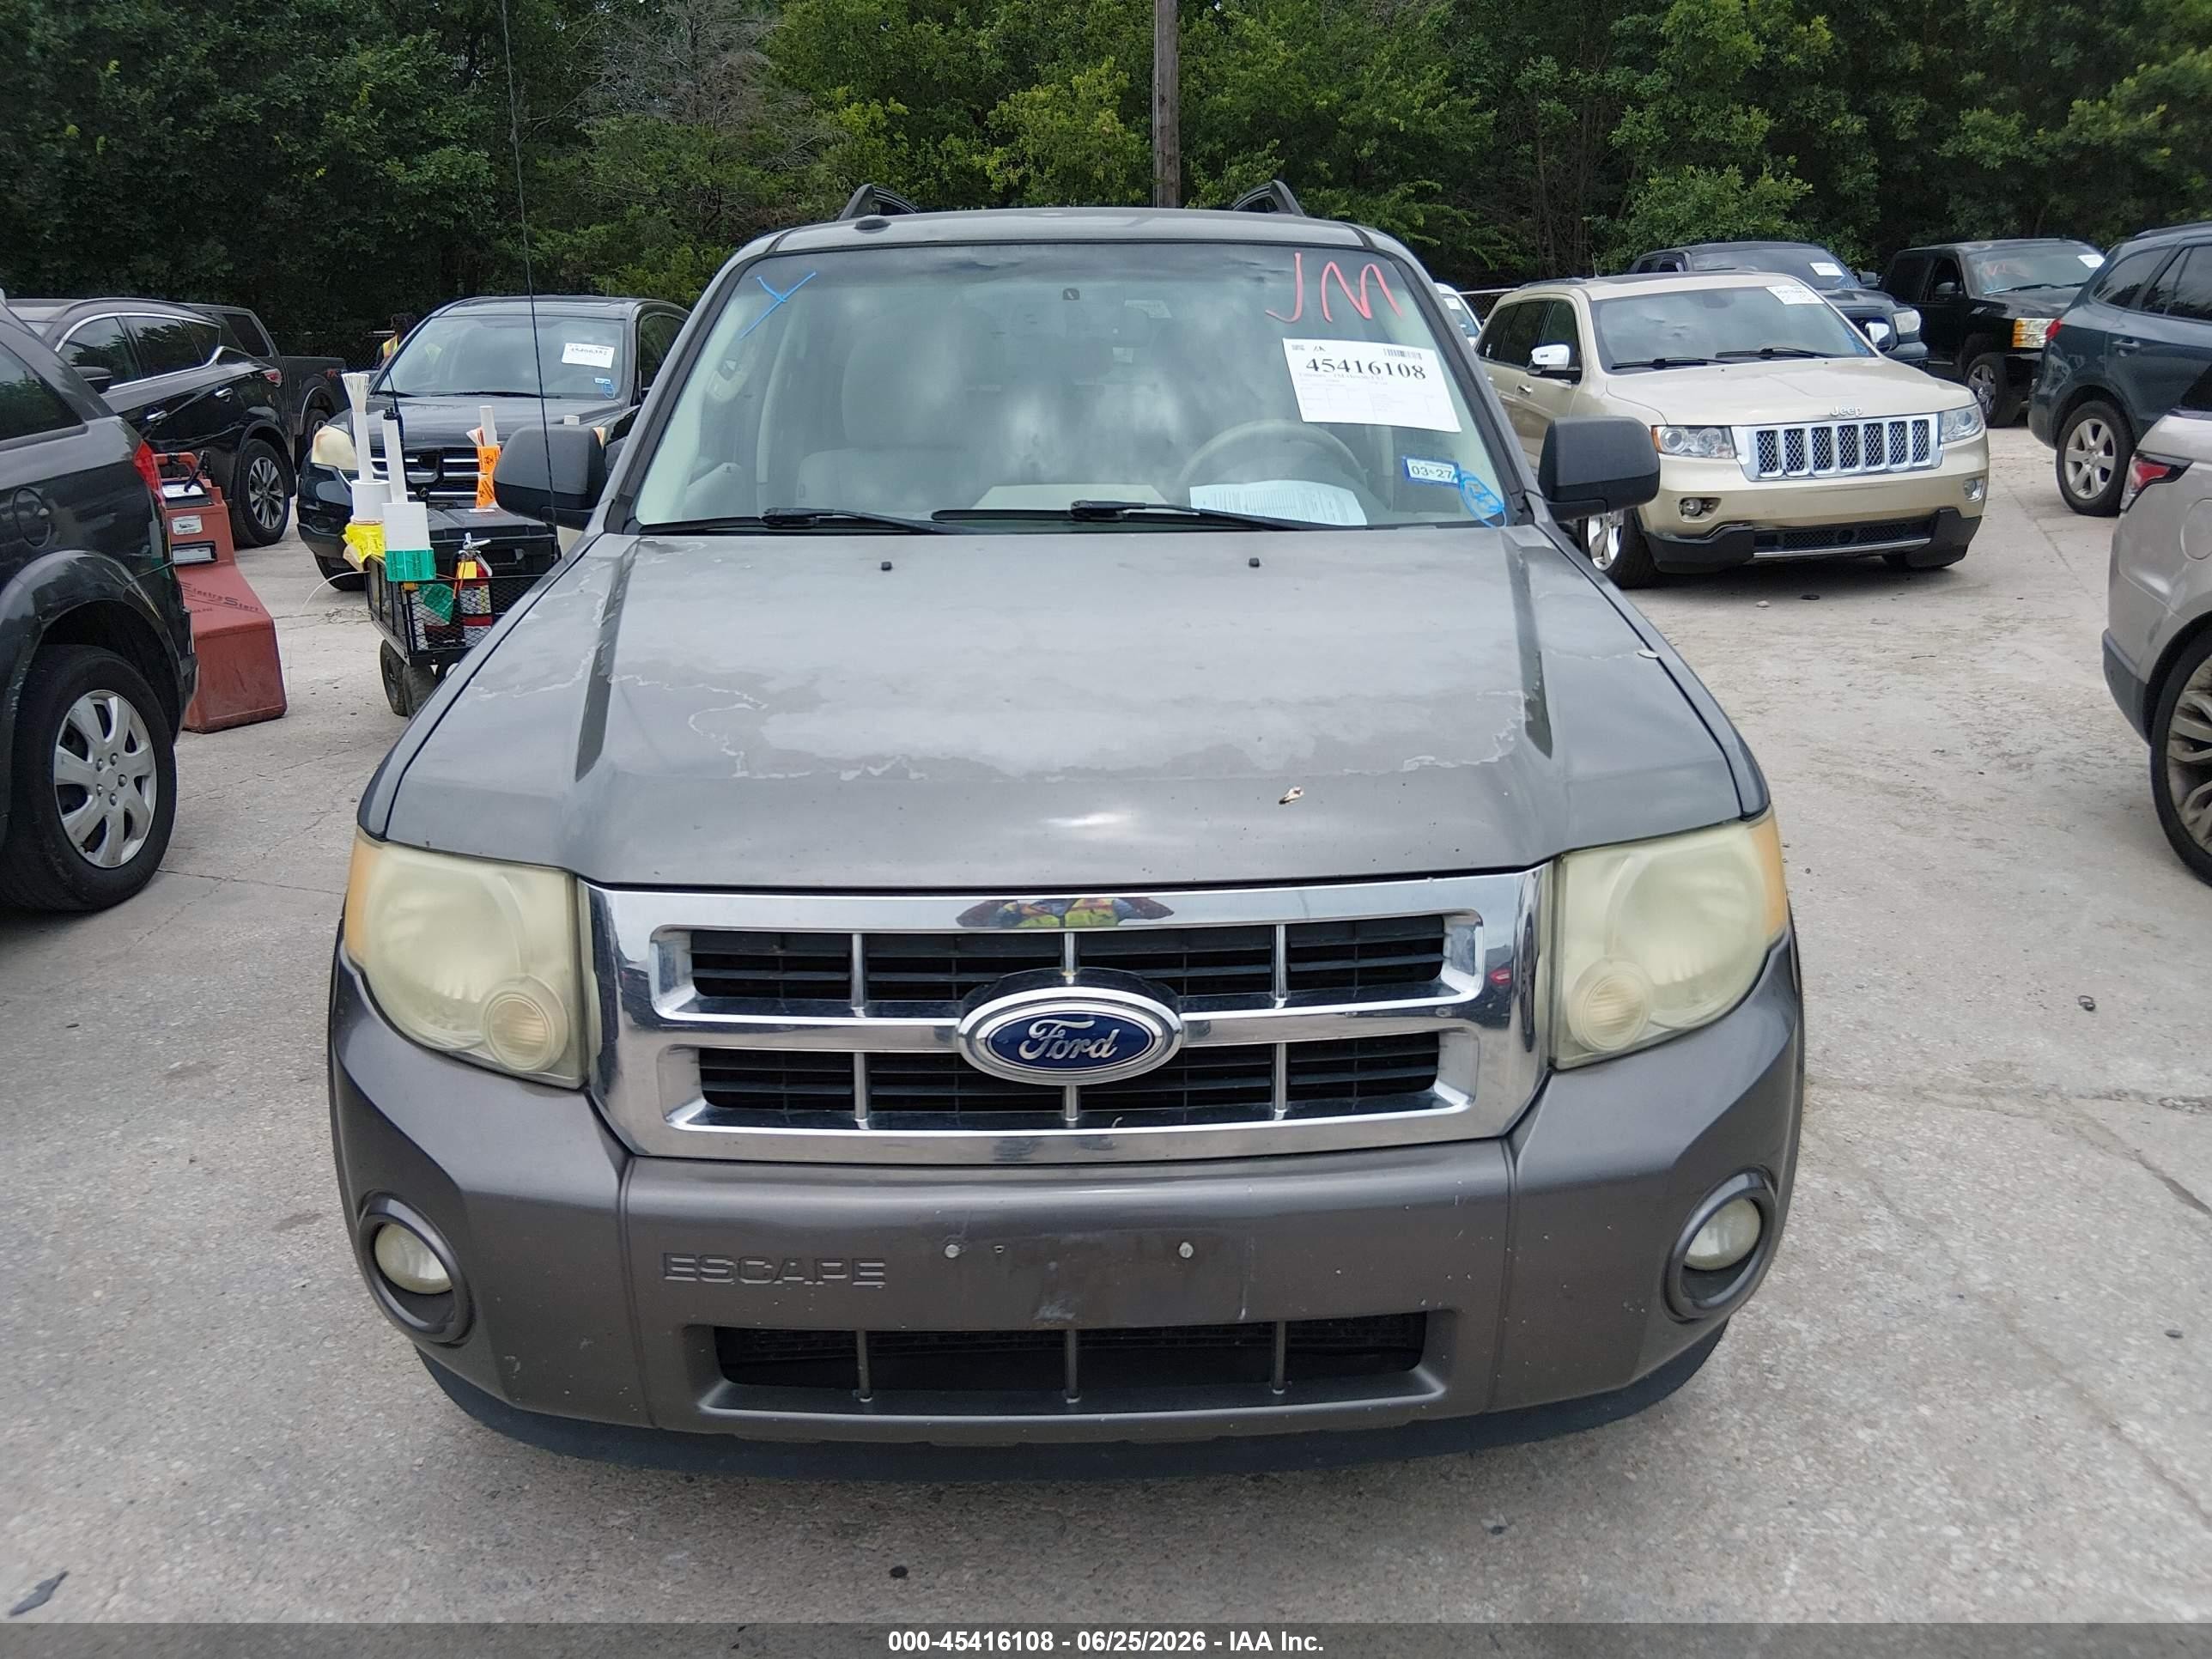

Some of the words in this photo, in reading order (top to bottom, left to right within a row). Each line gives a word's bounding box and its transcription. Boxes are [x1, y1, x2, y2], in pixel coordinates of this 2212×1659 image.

[1265, 252, 1405, 323] JM
[1305, 358, 1426, 380] 45416108
[1830, 405, 1863, 416] Jeep
[1018, 1018, 1120, 1060] Ford
[664, 1253, 886, 1286] ESCAPE
